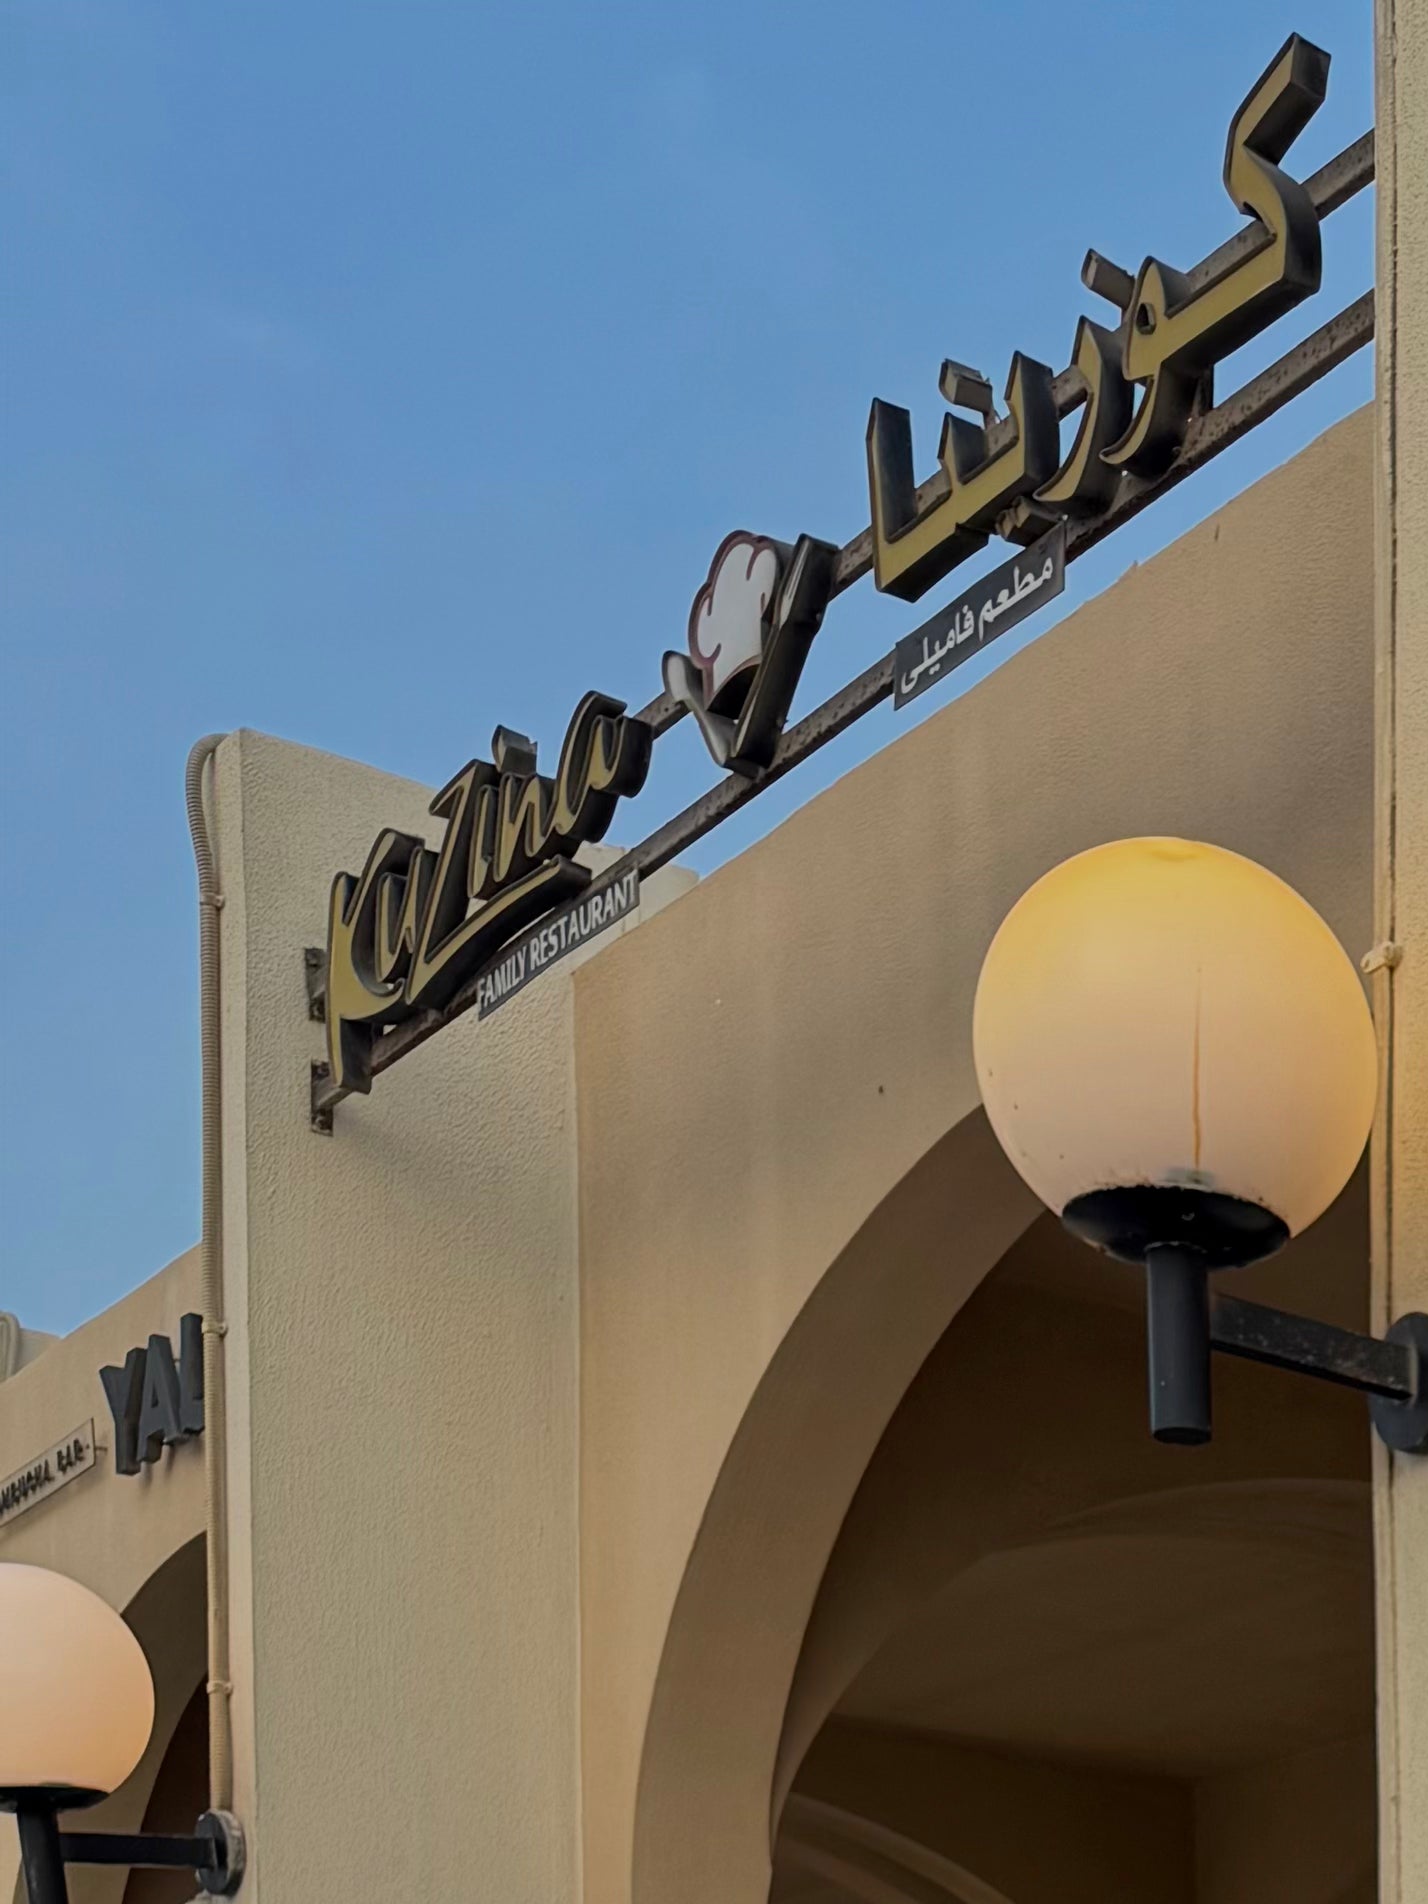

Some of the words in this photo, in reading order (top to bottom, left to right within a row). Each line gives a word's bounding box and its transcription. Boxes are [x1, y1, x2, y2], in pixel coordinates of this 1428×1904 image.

[867, 32, 1328, 598] كوزينا
[978, 556, 1054, 642] مطعم
[476, 943, 528, 1009] FAMILY
[529, 868, 639, 971] RESTAURANT
